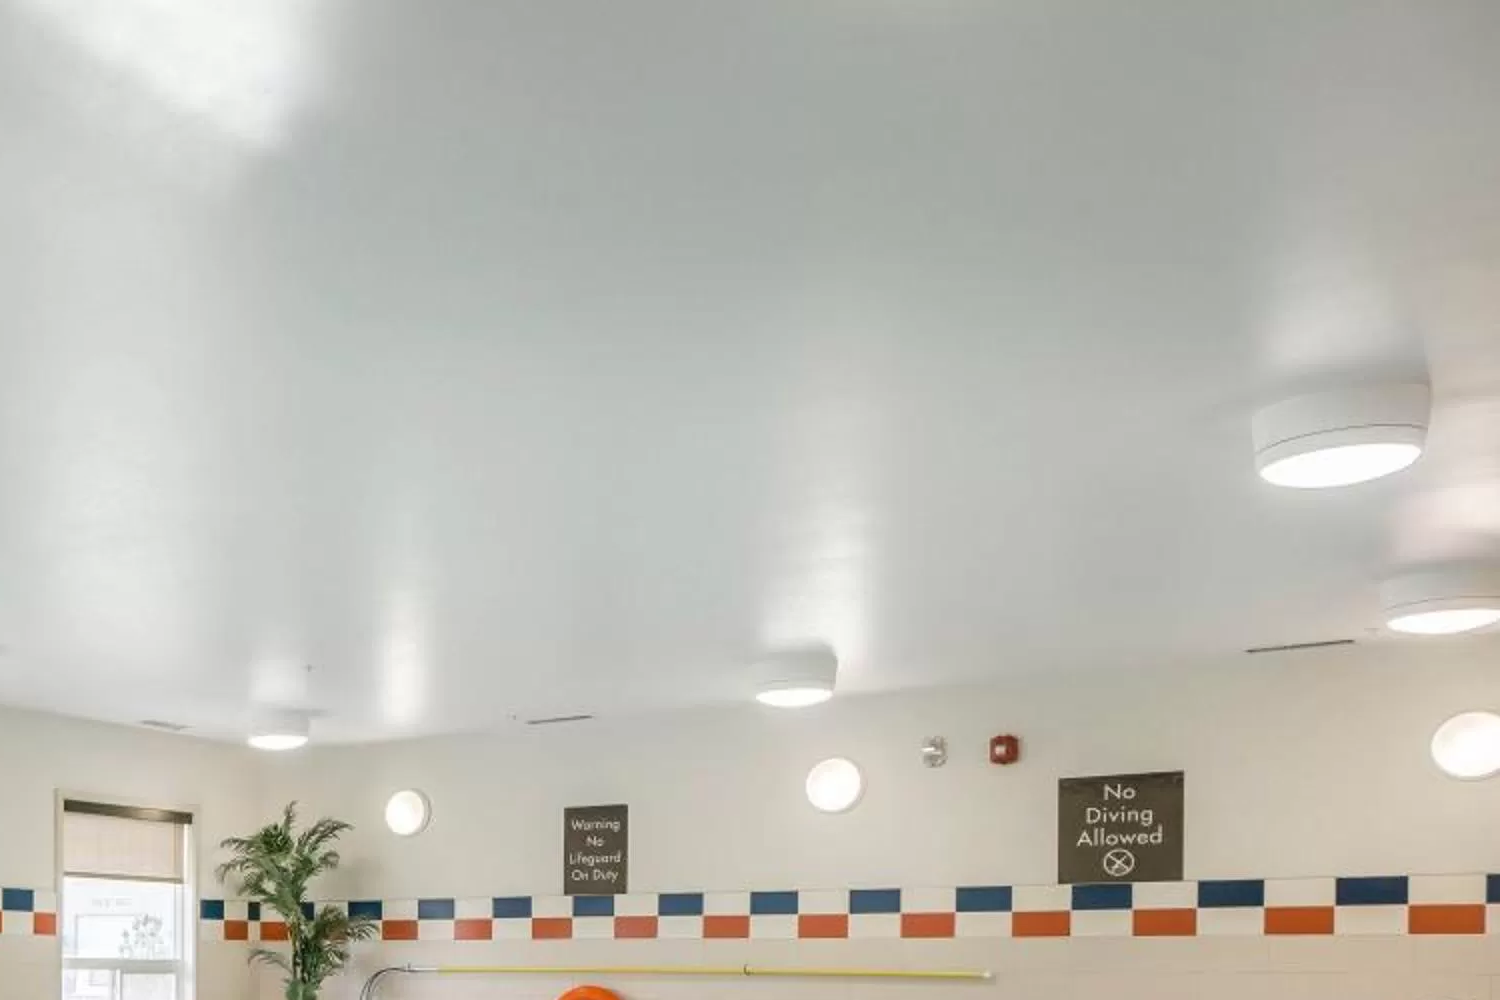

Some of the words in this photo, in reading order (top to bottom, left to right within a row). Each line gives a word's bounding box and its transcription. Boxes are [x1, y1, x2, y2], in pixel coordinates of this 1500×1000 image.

[1103, 783, 1136, 800] No
[1085, 806, 1153, 827] Diving
[571, 818, 620, 833] Warning
[585, 835, 605, 847] No
[1076, 825, 1163, 847] Allowed
[569, 849, 621, 867] Lifeguard
[571, 868, 589, 881] On
[593, 868, 619, 883] Duty
